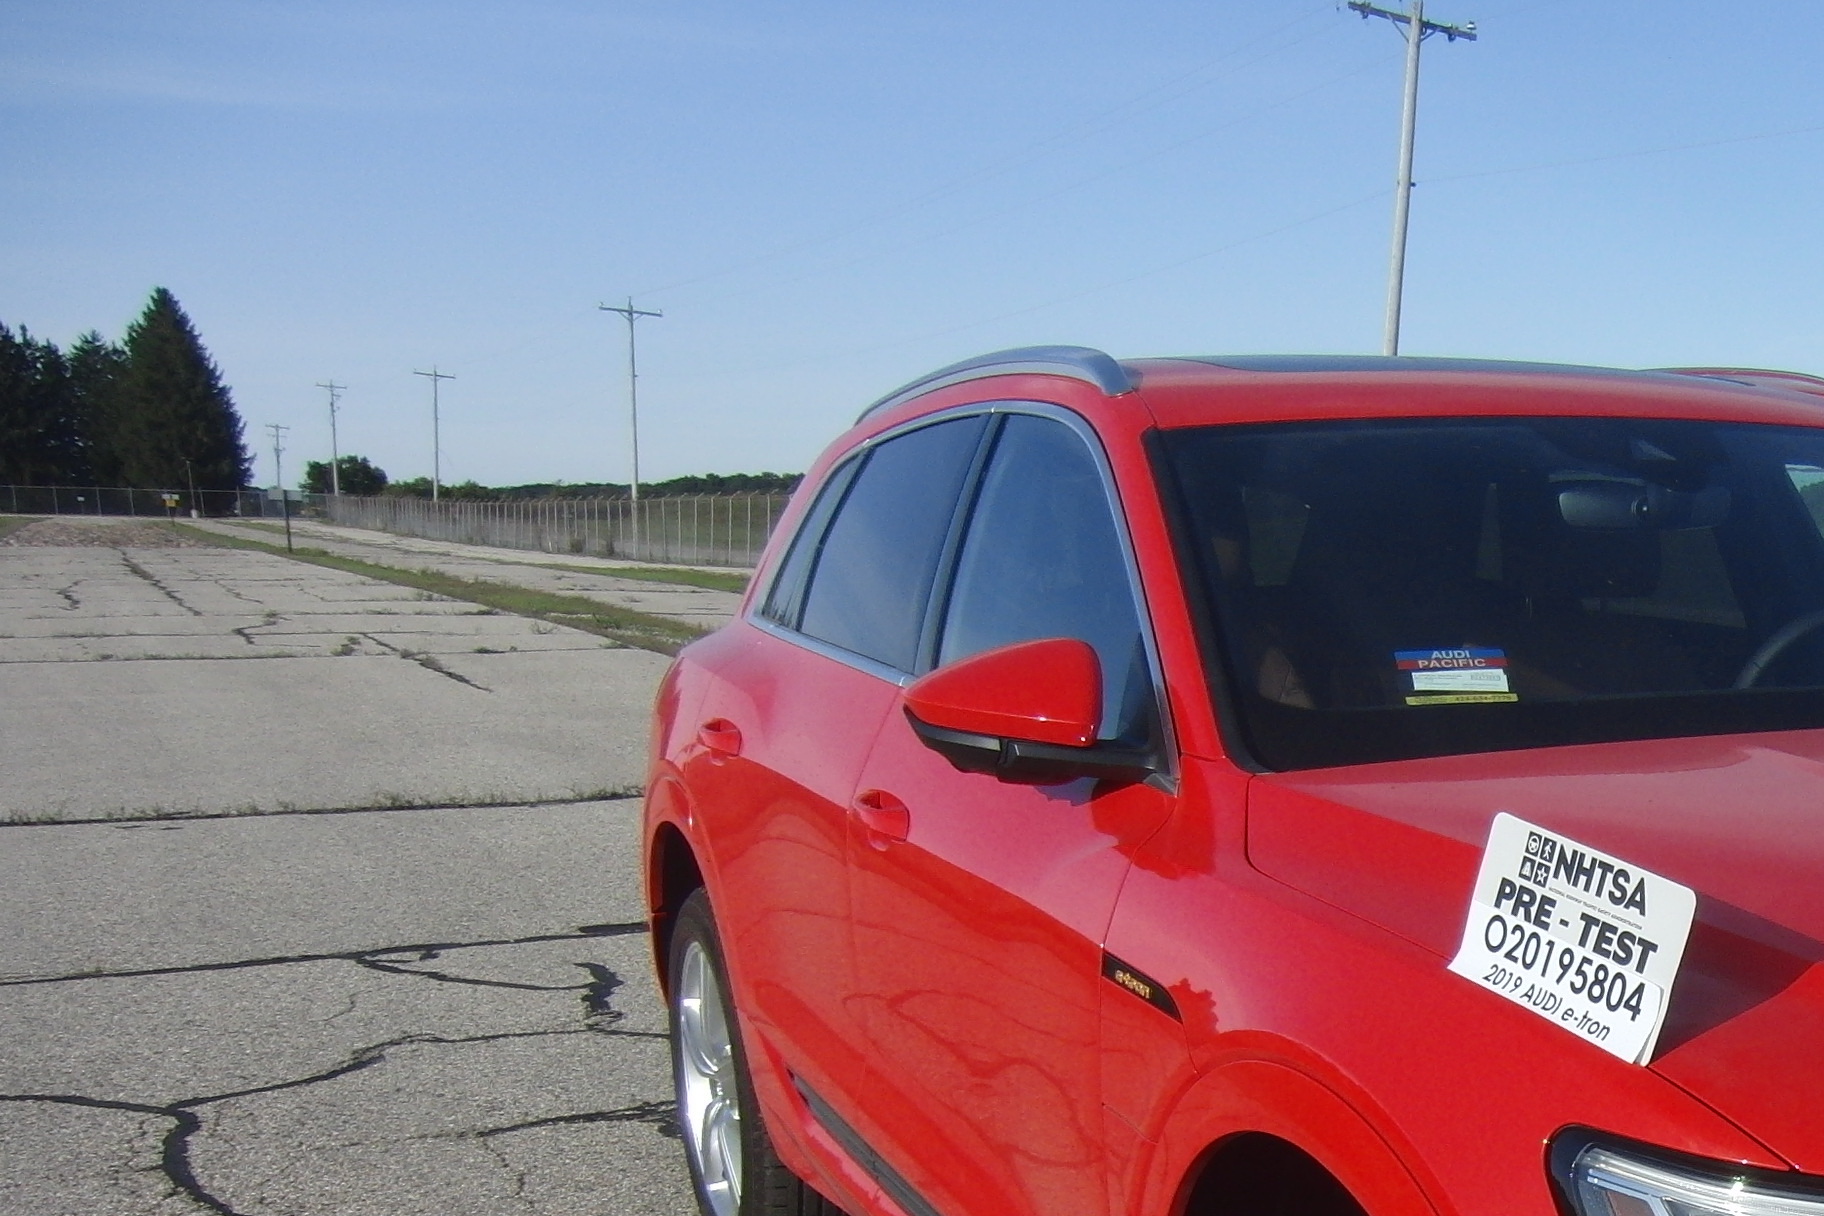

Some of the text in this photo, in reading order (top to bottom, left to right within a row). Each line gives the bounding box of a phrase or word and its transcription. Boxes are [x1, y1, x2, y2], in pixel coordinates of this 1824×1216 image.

[1418, 659, 1486, 668] PACIFIC
[1431, 650, 1470, 659] AUDI
[1552, 843, 1647, 917] NHTSA
[1493, 876, 1557, 931] PRE
[1577, 911, 1659, 975] TEST
[1482, 963, 1611, 1041] 2019 AUDI e-tron
